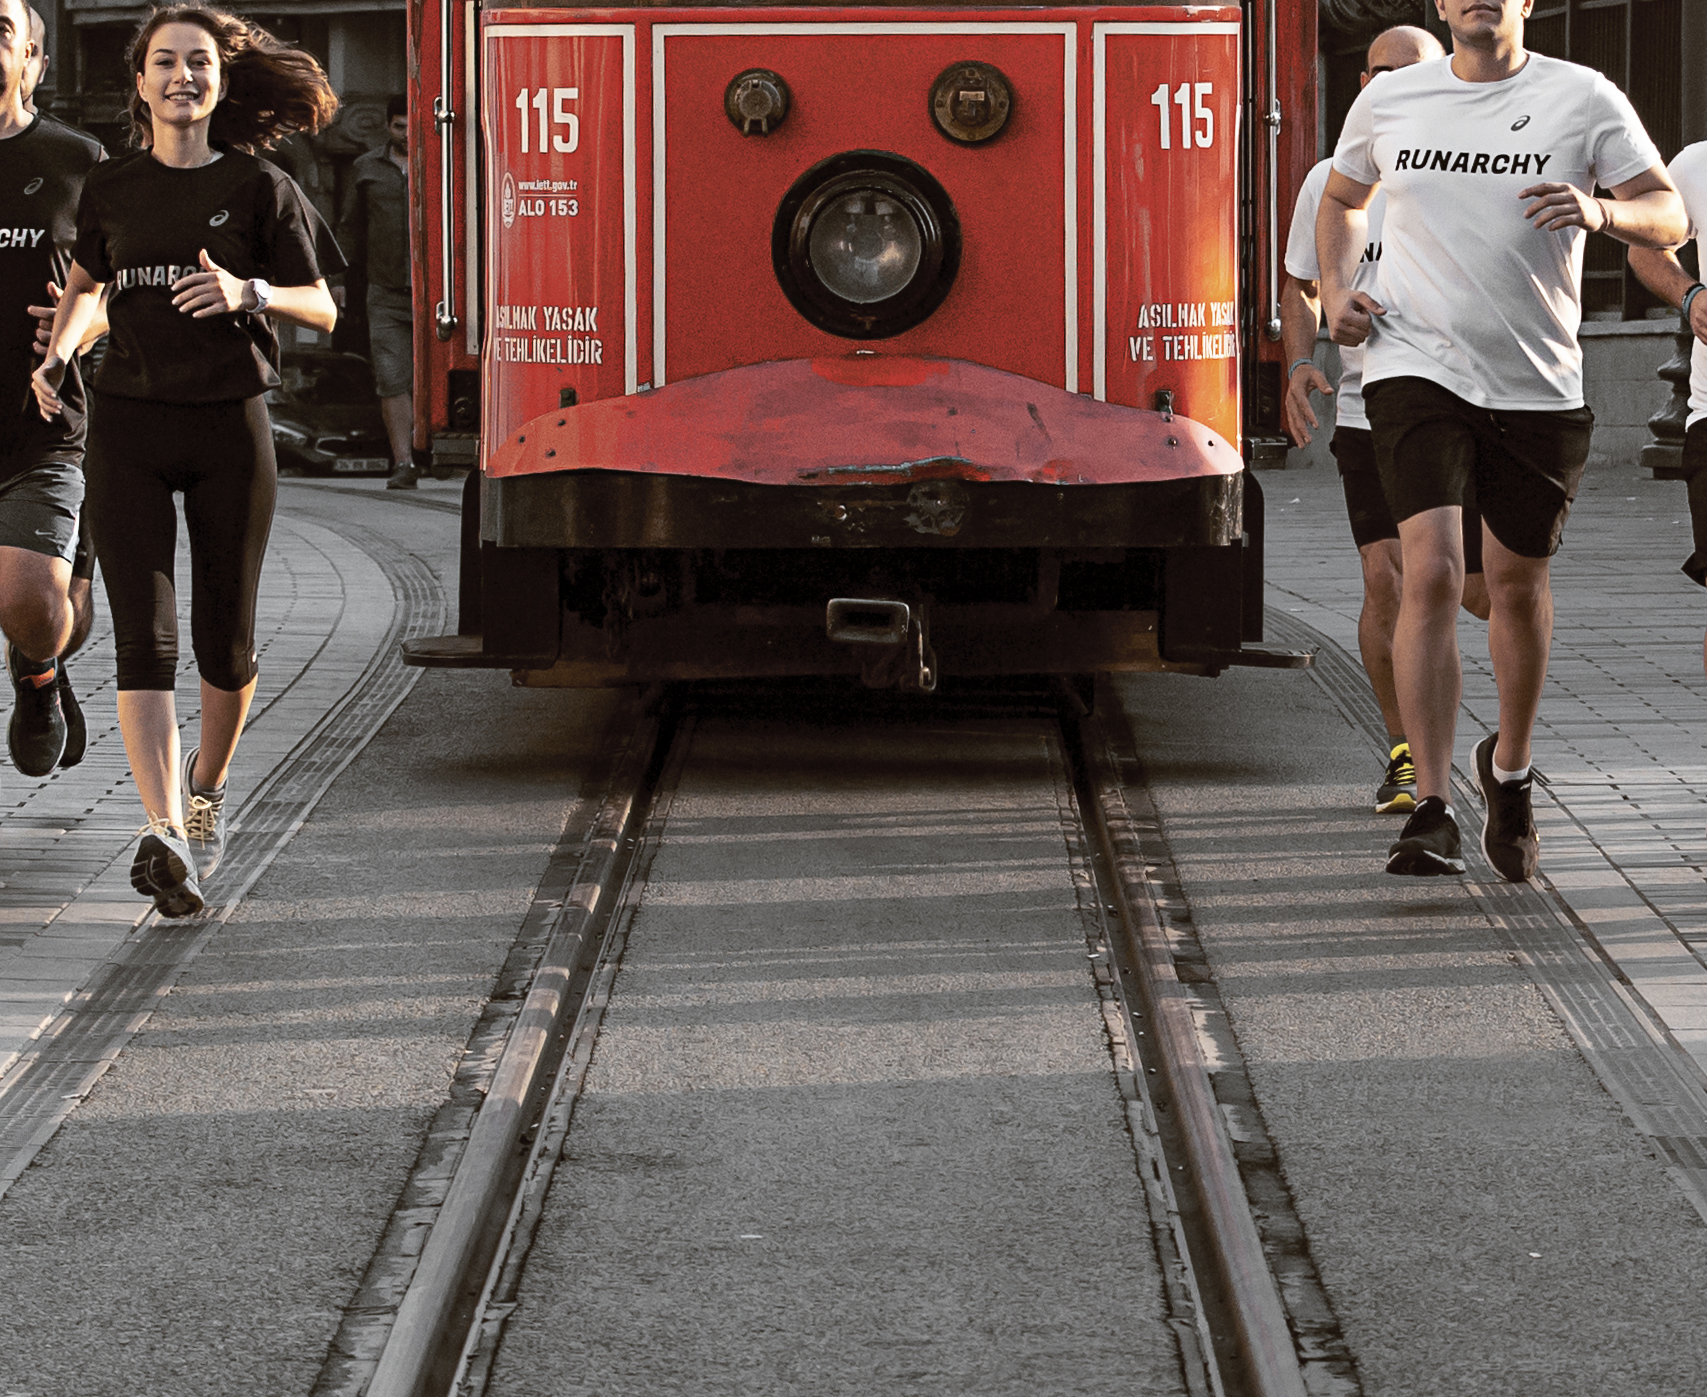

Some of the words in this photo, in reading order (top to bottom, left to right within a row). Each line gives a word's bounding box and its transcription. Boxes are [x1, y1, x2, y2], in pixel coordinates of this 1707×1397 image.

[515, 87, 580, 154] 115
[1151, 82, 1214, 150] 115
[1395, 148, 1552, 175] RUNARCHY
[518, 199, 545, 217] ALO
[549, 199, 579, 217] 153
[543, 306, 599, 332] YASAK
[1138, 302, 1206, 329] ASILMAK
[1129, 336, 1154, 362] VE
